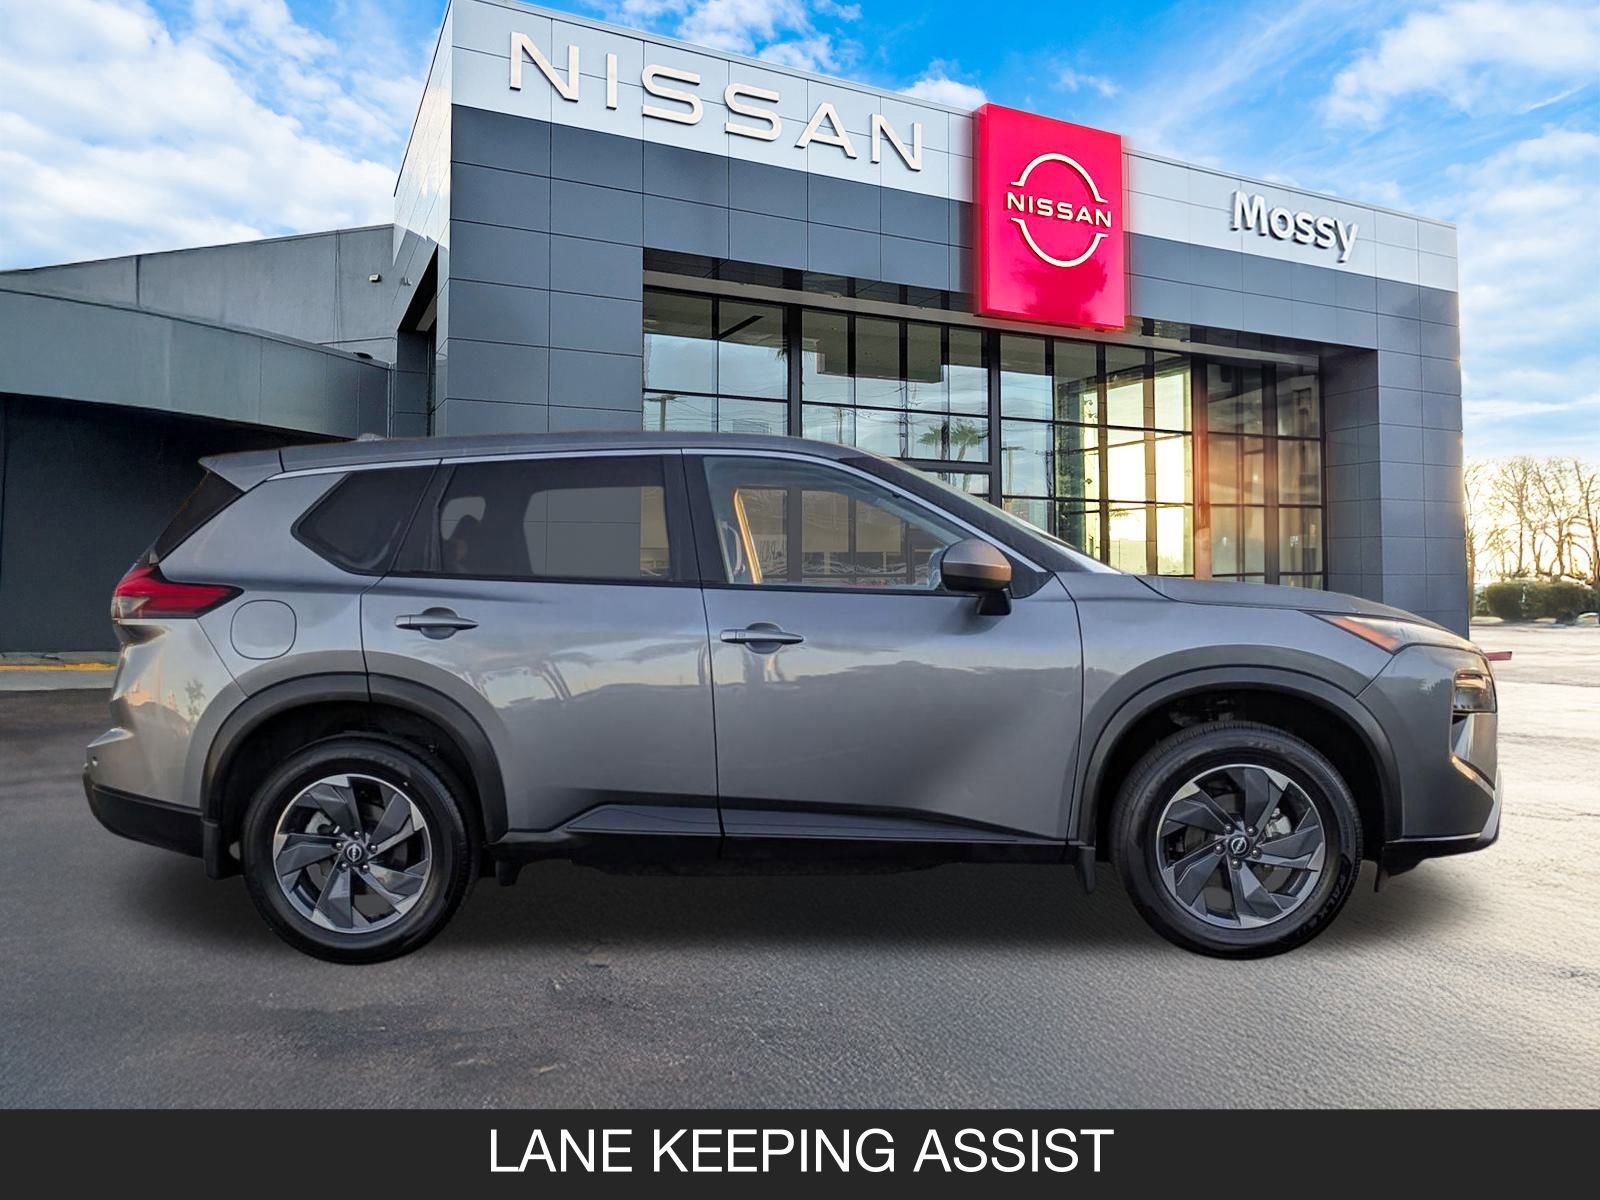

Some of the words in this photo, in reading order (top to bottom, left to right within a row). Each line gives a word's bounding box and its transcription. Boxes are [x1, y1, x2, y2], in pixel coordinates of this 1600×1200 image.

[509, 31, 923, 172] NISSAN
[1007, 191, 1112, 228] NISSAN
[1230, 190, 1359, 263] Mossy
